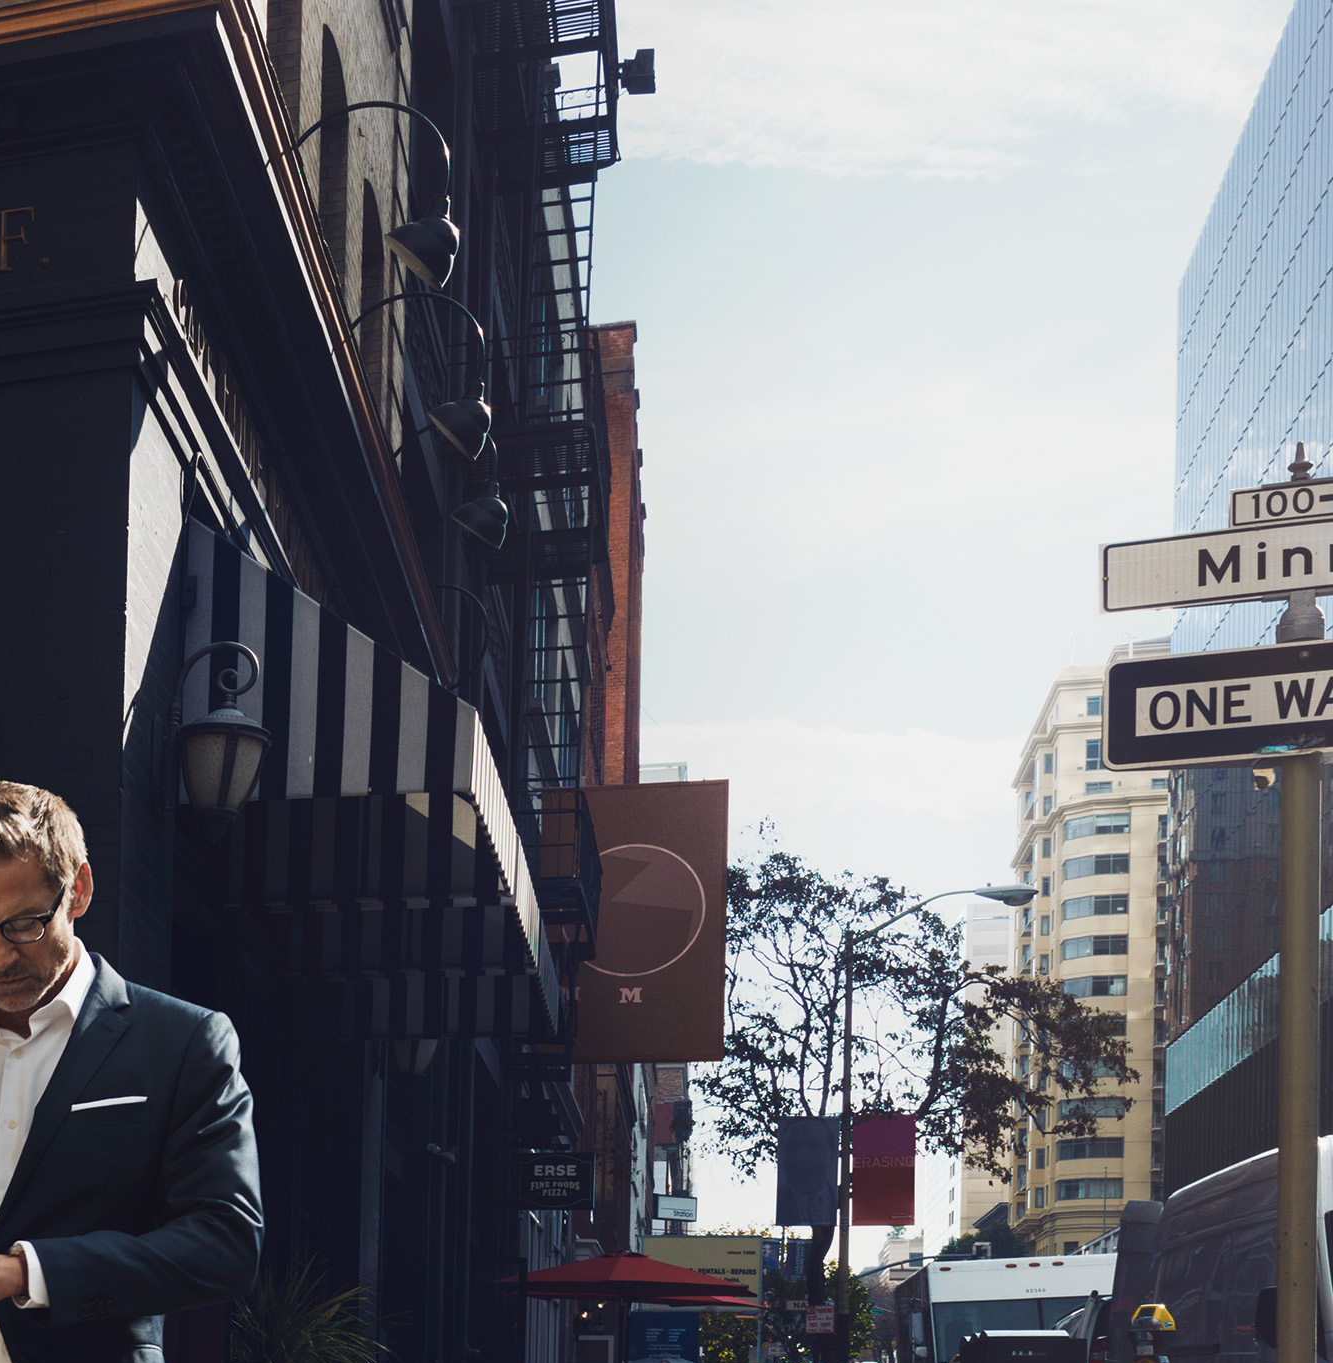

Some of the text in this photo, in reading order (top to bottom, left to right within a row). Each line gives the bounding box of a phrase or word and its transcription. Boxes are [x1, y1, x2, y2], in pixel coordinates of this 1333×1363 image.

[1198, 541, 1333, 587] Min
[1148, 683, 1253, 732] ONE
[619, 987, 643, 1003] M
[853, 1155, 914, 1168] ERASING
[534, 1164, 577, 1176] ERSE
[530, 1181, 580, 1191] FINE FOODS
[542, 1189, 568, 1197] PIZZA
[730, 1268, 757, 1276] REPAIRS
